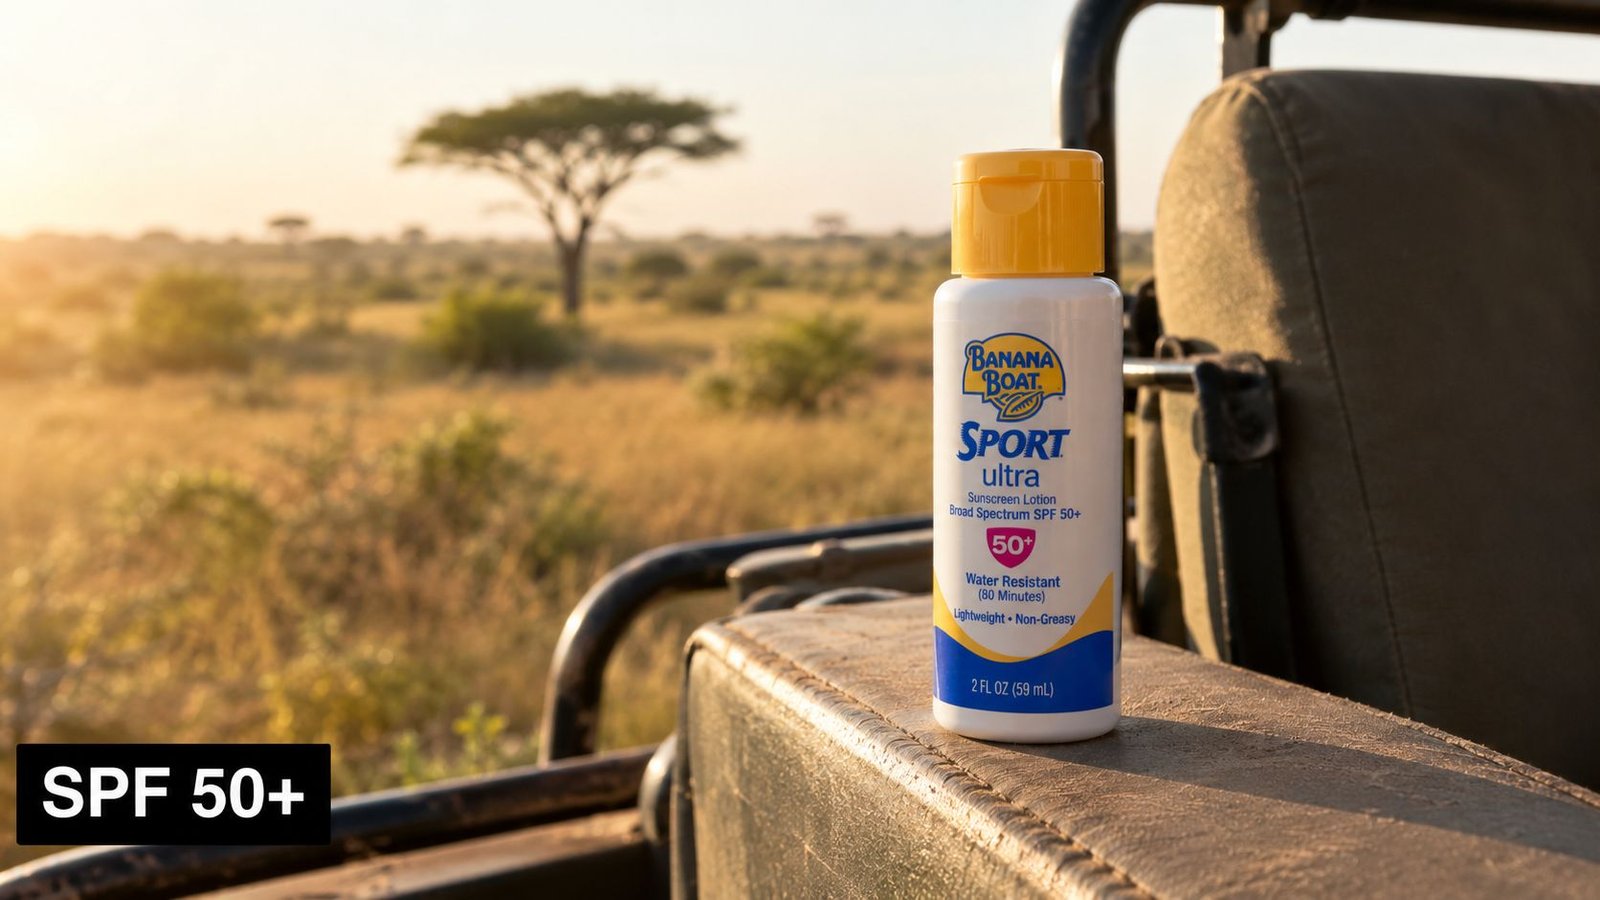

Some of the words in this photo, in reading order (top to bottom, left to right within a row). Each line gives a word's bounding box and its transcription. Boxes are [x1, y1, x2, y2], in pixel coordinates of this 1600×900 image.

[968, 345, 1054, 371] BANANA
[982, 369, 1040, 396] BOAT
[956, 421, 1071, 461] SPORT
[983, 463, 1040, 487] ultra
[968, 492, 1020, 504] Sunscreen
[1023, 494, 1056, 505] Lotion
[949, 504, 973, 517] Broad
[976, 507, 1030, 520] Spectrum
[1033, 508, 1057, 520] SPF
[1060, 508, 1081, 519] 50+
[992, 535, 1033, 555] 50+
[966, 572, 999, 586] Water
[1002, 575, 1061, 588] Resistant
[978, 588, 995, 601] (80
[998, 591, 1045, 604] Minutes)
[954, 608, 1005, 624] Lightweight
[1015, 613, 1076, 625] Non-Greasy
[971, 678, 977, 692] 2
[980, 680, 991, 694] FL
[994, 680, 1009, 695] OZ
[1012, 682, 1030, 698] (59
[1033, 682, 1054, 698] mL)
